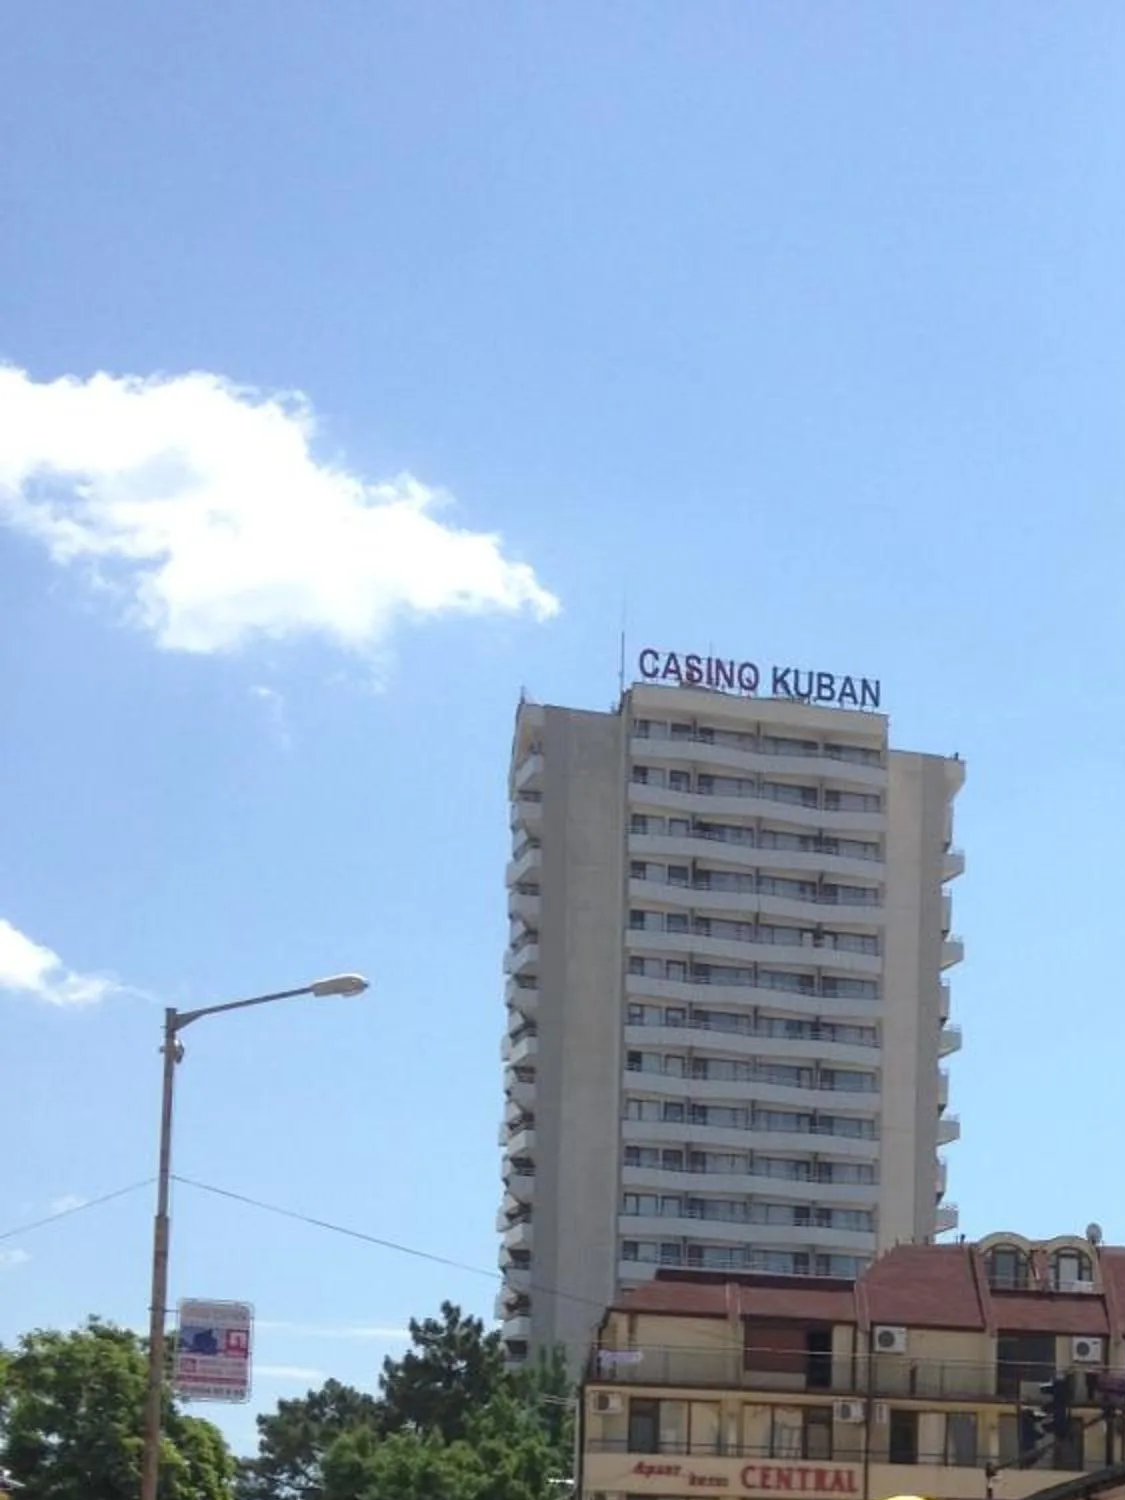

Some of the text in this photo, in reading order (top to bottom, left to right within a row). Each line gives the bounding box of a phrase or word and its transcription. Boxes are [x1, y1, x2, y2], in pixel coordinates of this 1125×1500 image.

[639, 649, 880, 708] CASINO KUBAN
[740, 1465, 859, 1492] CENTRAL
